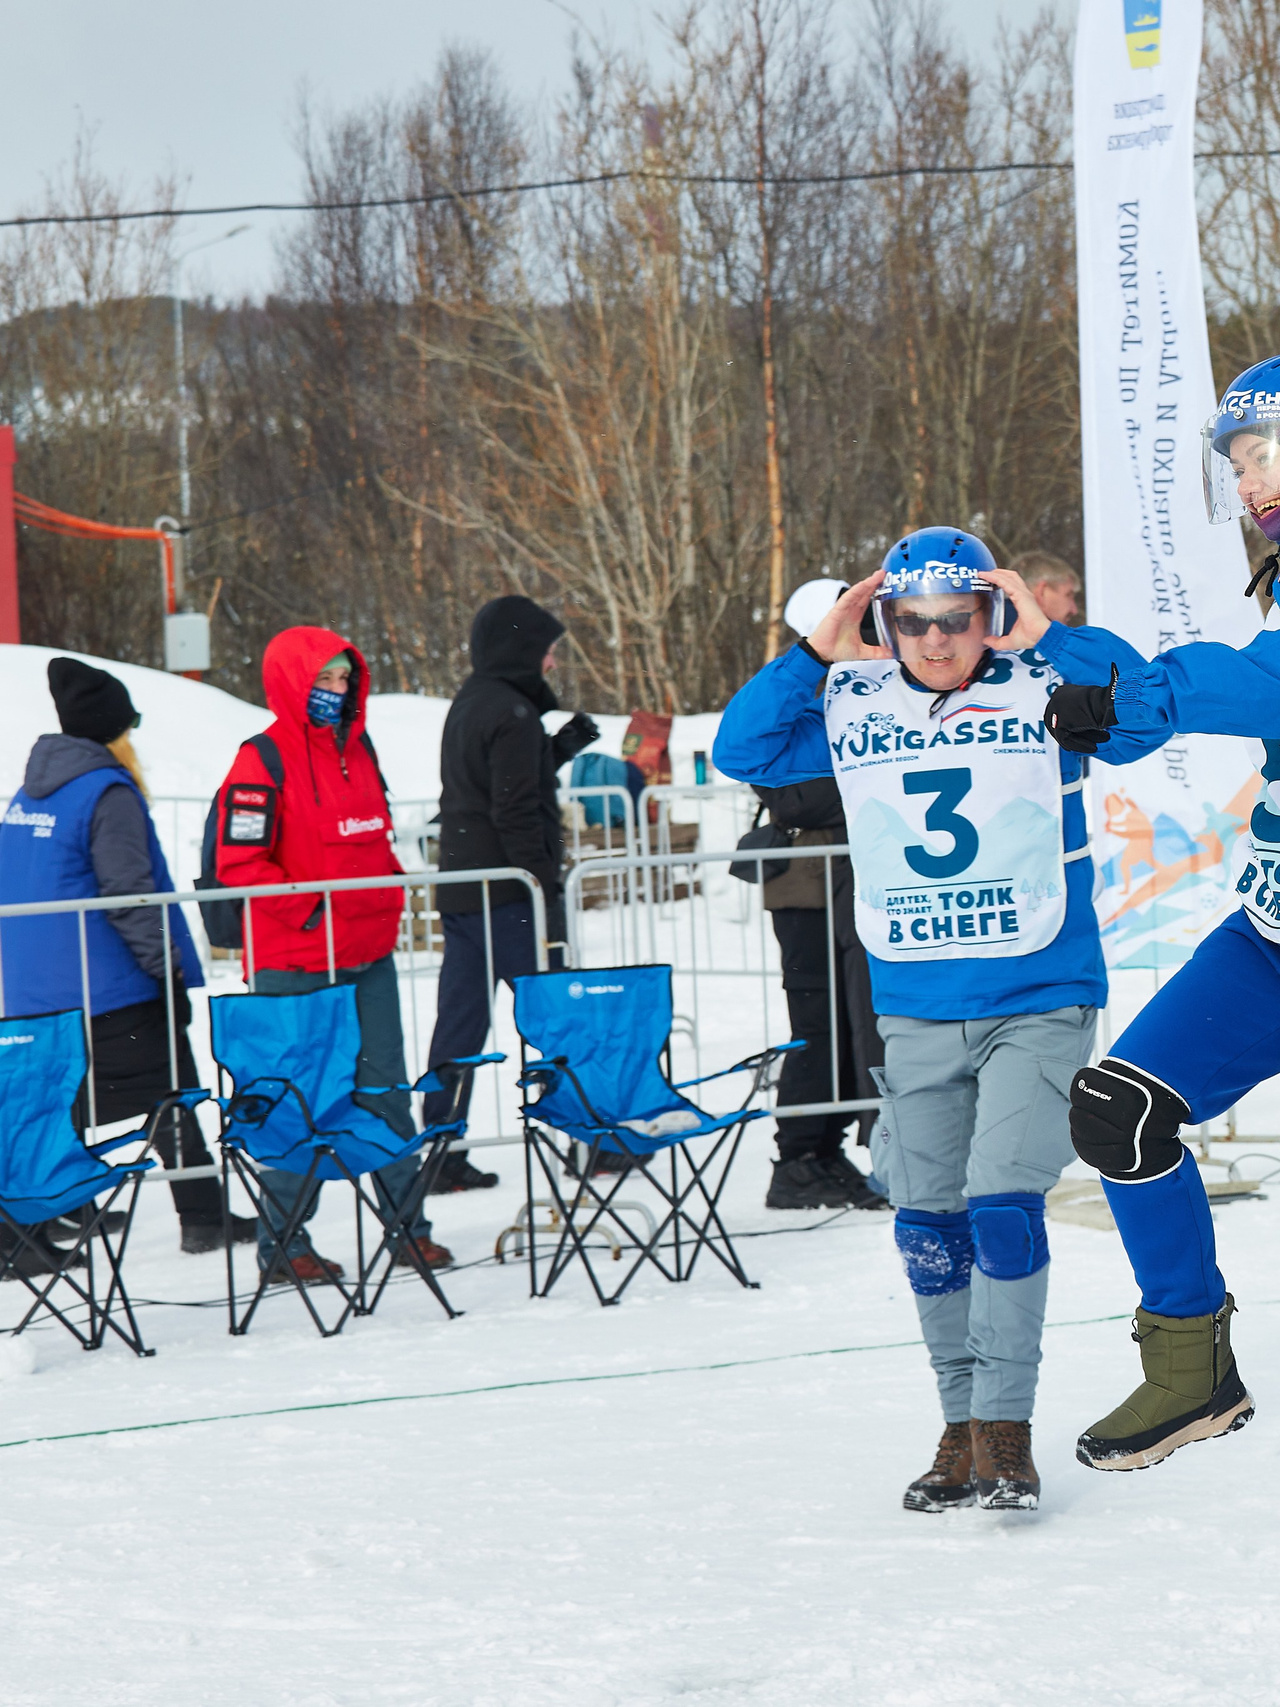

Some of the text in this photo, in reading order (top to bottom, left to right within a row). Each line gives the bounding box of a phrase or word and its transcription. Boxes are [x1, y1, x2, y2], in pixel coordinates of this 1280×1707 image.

[902, 767, 980, 880] 3
[1236, 861, 1258, 894] В
[886, 897, 905, 907] ДЛЯ
[903, 905, 932, 915] ЗНАЕТ
[938, 886, 1016, 911] ТОЛК
[888, 909, 1019, 943] В СНЕГЕ
[1083, 1086, 1113, 1101] LARSEN
